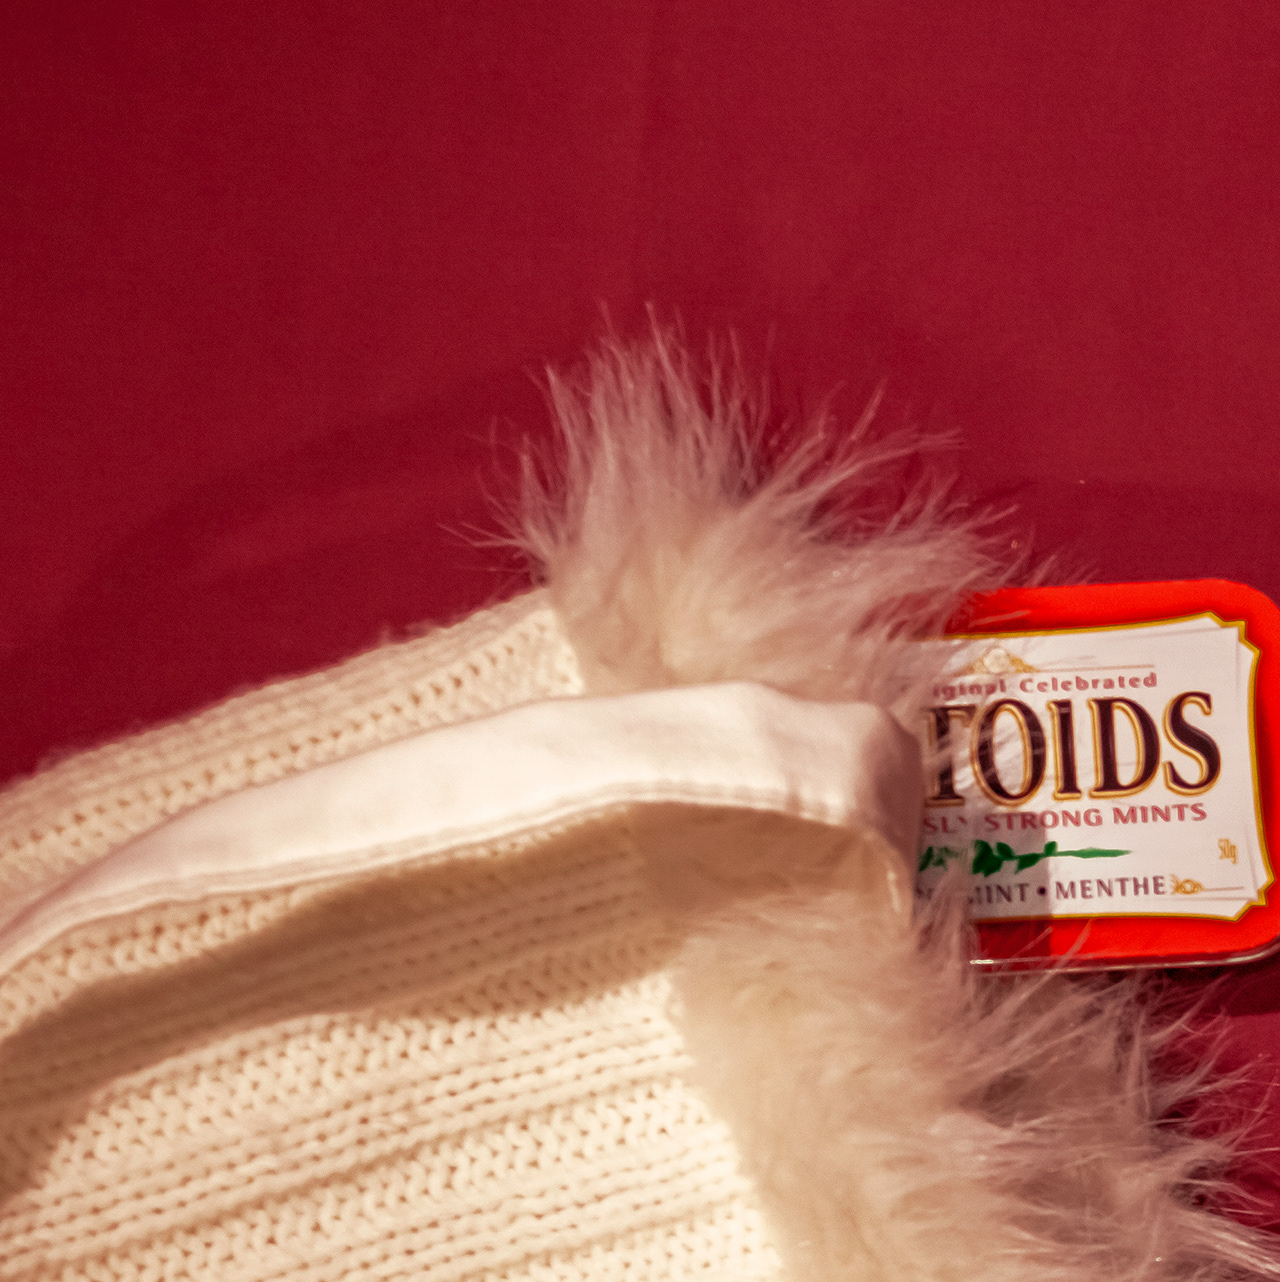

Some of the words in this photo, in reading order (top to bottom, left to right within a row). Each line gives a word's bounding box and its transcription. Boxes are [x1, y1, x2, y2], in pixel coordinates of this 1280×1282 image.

[1019, 671, 1157, 693] Celebrated
[984, 808, 1103, 832] STRONG
[1112, 803, 1206, 826] MINTS
[1055, 876, 1165, 900] MENTHE
